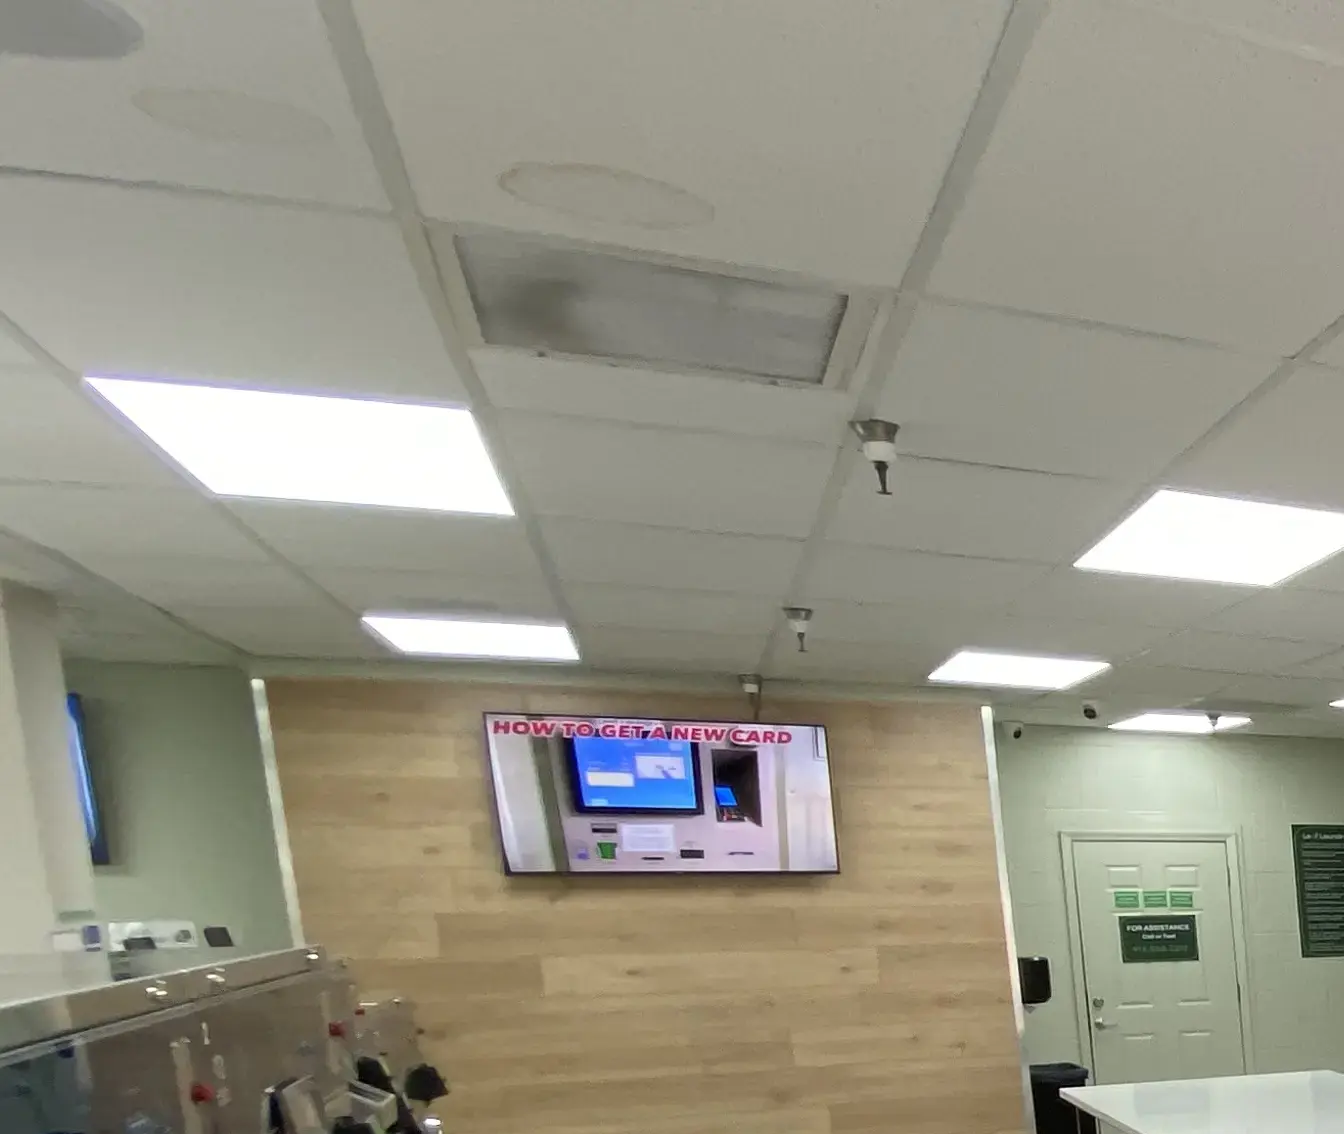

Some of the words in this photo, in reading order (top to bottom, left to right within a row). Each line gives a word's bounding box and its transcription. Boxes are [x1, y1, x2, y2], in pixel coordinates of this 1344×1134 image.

[493, 721, 555, 736] HOW
[562, 722, 591, 736] TO
[601, 724, 643, 738] GET
[650, 726, 667, 740] A
[674, 727, 727, 742] NEW
[730, 729, 792, 744] CARD
